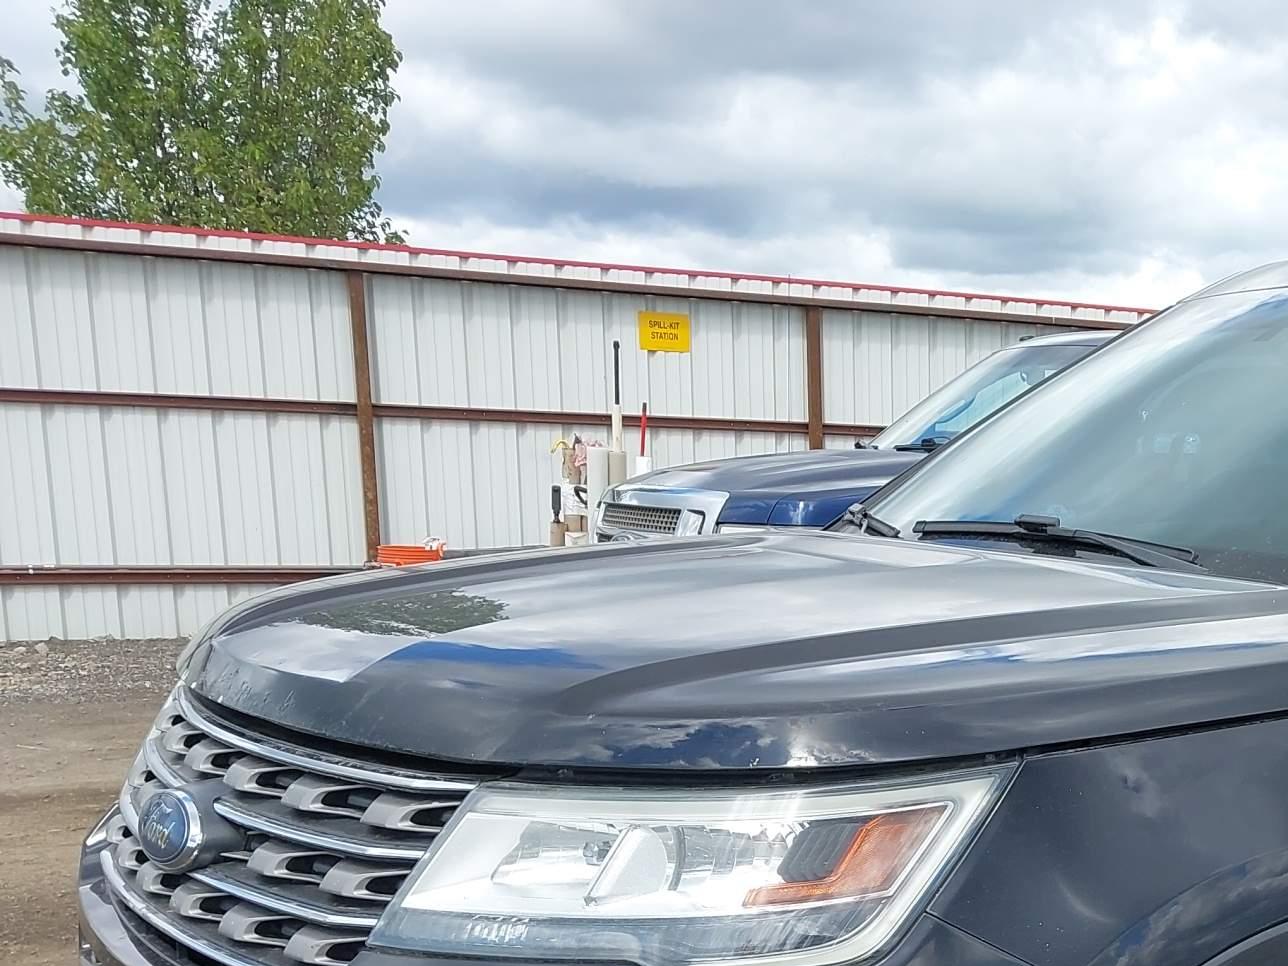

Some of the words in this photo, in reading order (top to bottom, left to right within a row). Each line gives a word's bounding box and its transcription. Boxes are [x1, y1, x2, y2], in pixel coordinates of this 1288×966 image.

[648, 320, 680, 330] SPILL-KIT
[650, 331, 679, 341] STATION
[142, 798, 177, 849] Ford
